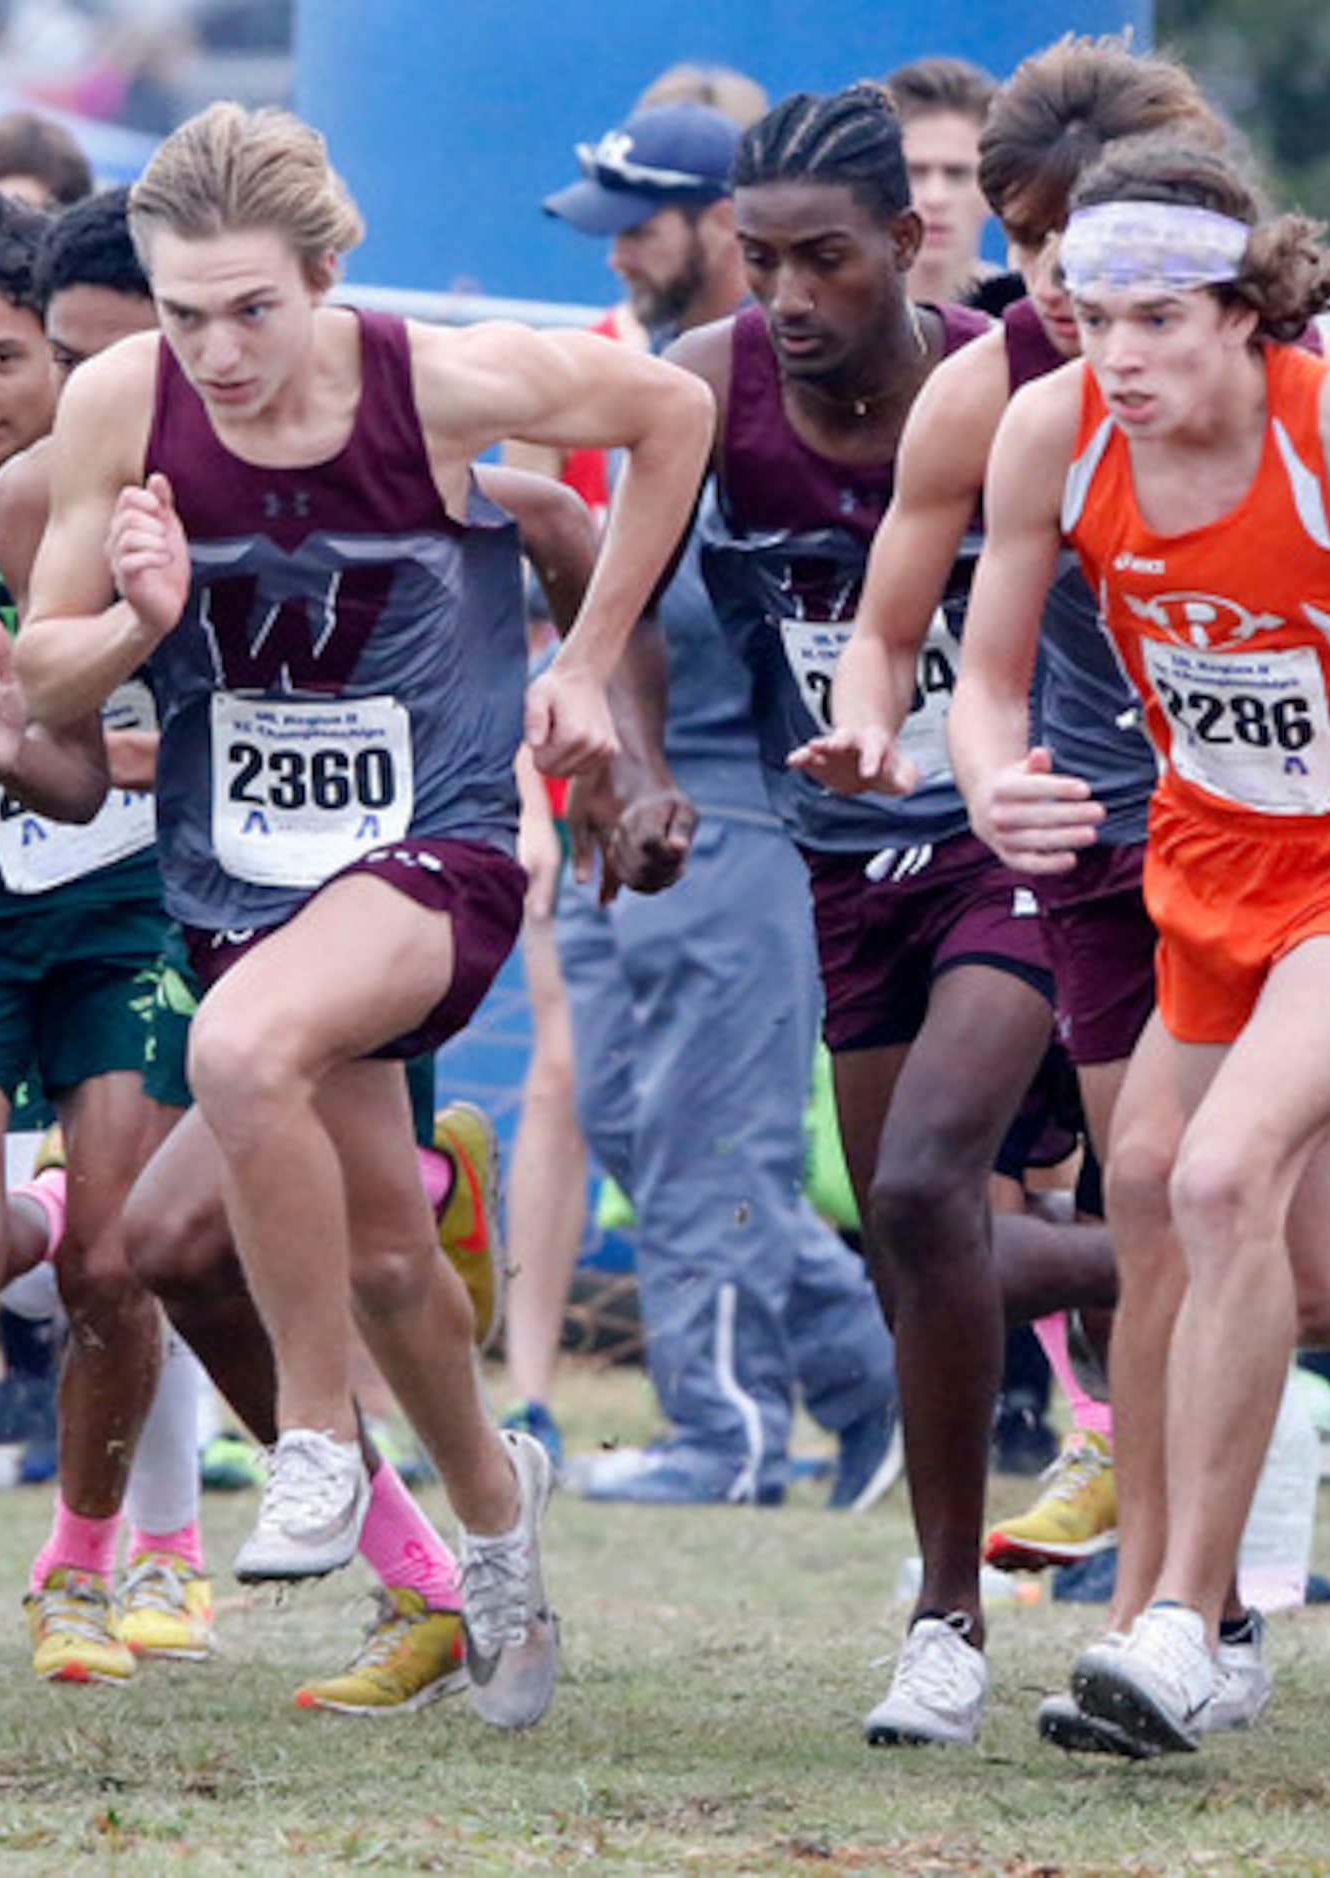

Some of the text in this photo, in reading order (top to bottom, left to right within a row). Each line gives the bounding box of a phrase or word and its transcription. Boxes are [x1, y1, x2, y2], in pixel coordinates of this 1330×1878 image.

[199, 559, 397, 700] W
[1155, 677, 1313, 751] 2286
[228, 742, 395, 810] 2360
